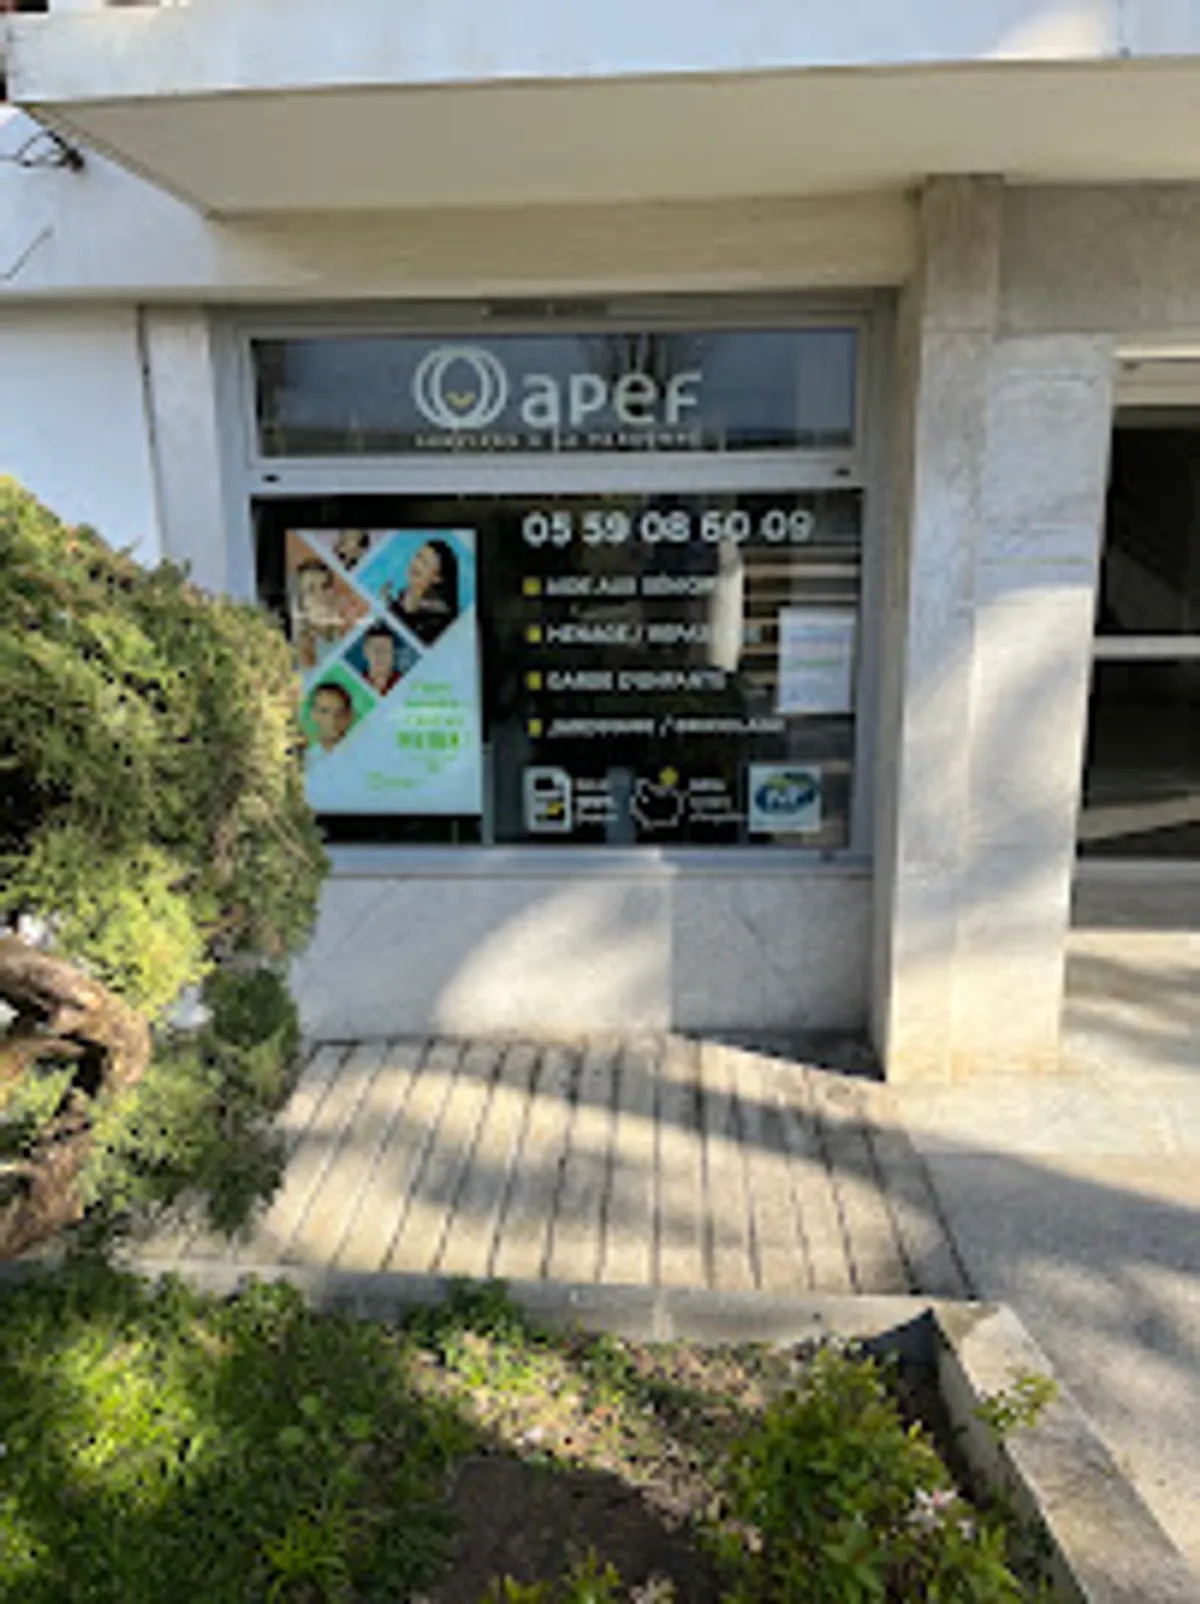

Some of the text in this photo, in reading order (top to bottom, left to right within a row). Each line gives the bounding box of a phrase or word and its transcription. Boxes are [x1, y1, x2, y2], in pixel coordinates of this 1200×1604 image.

[522, 508, 815, 546] 05 59 08 60 09
